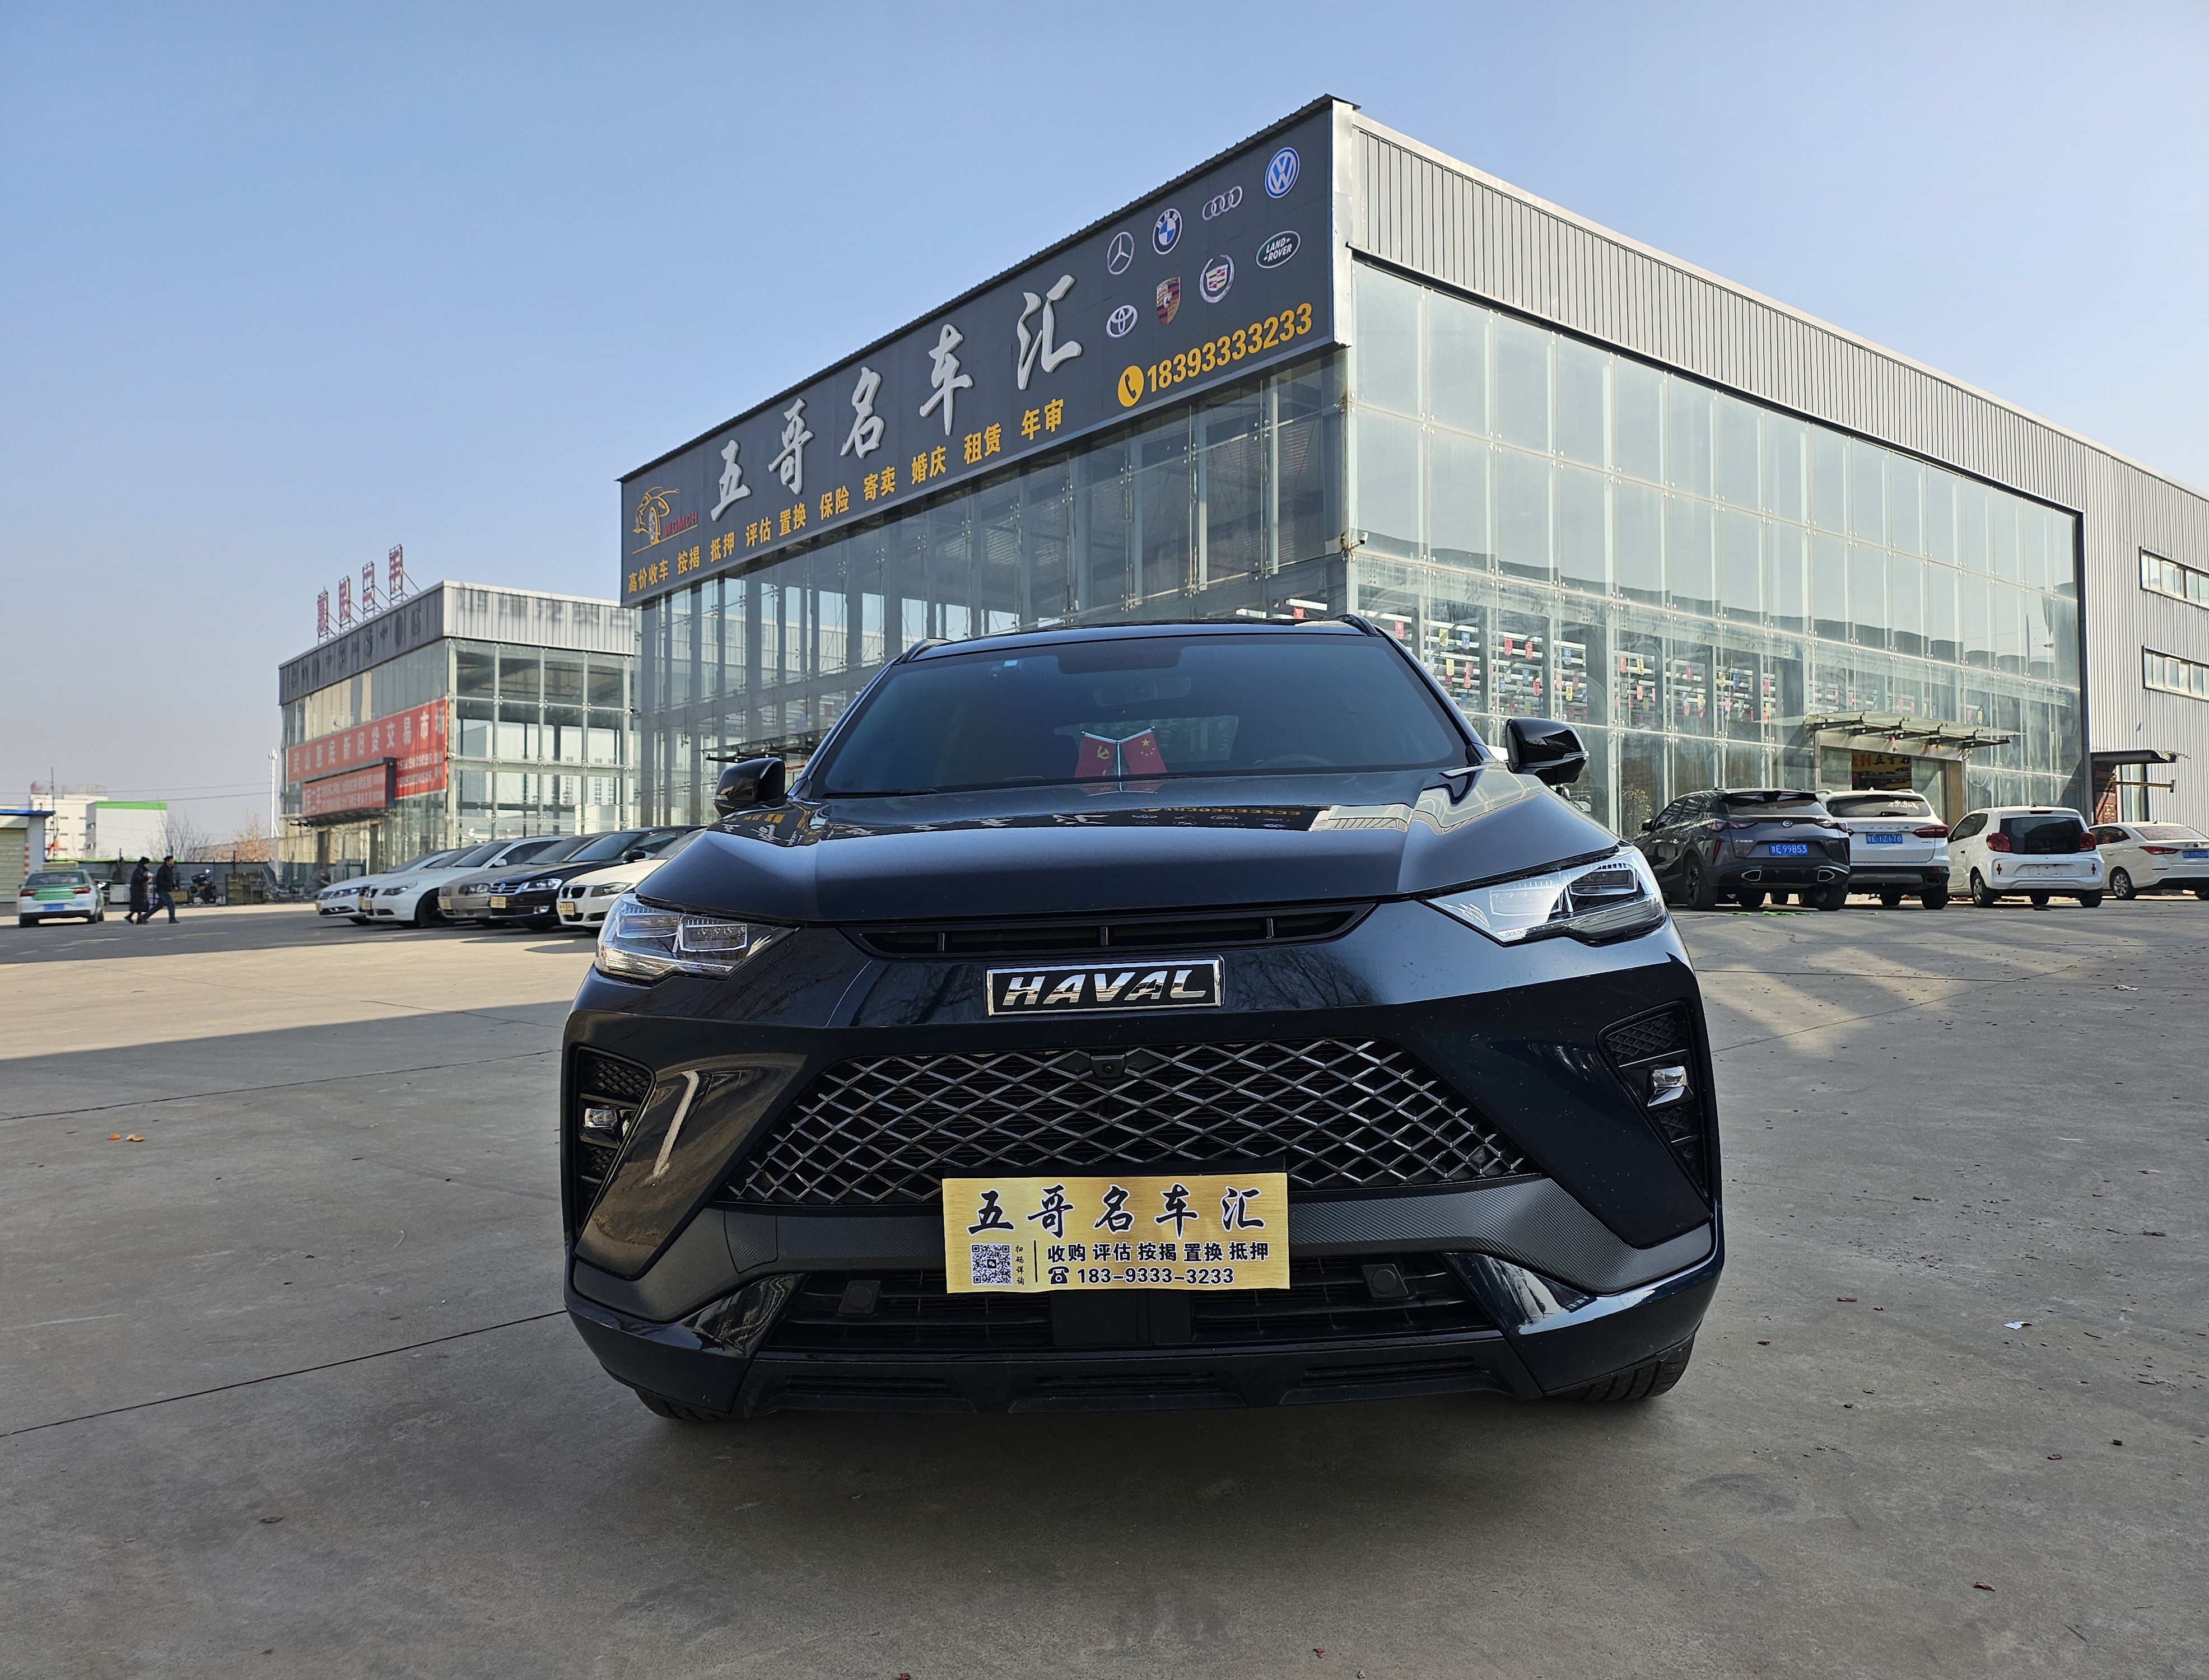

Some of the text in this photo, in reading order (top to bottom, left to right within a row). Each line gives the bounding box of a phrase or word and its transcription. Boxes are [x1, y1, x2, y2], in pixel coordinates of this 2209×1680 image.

[1265, 237, 1287, 254] LAND
[1266, 243, 1293, 262] ROVER
[1147, 302, 1312, 392] 18393333233
[710, 274, 1083, 522] 五哥名车汇
[628, 398, 1064, 594] 高价收车 按揭 抵押 评估 置换 保险 寄卖 婚庆 租赁 年审
[664, 510, 698, 536] WGMCH
[1002, 969, 1206, 1006] HAVAL
[968, 1183, 1266, 1239] 五哥名车汇
[1047, 1242, 1270, 1263] 收购 评估 按揭 置换 抵押
[1076, 1267, 1234, 1285] 183-9333-3233
